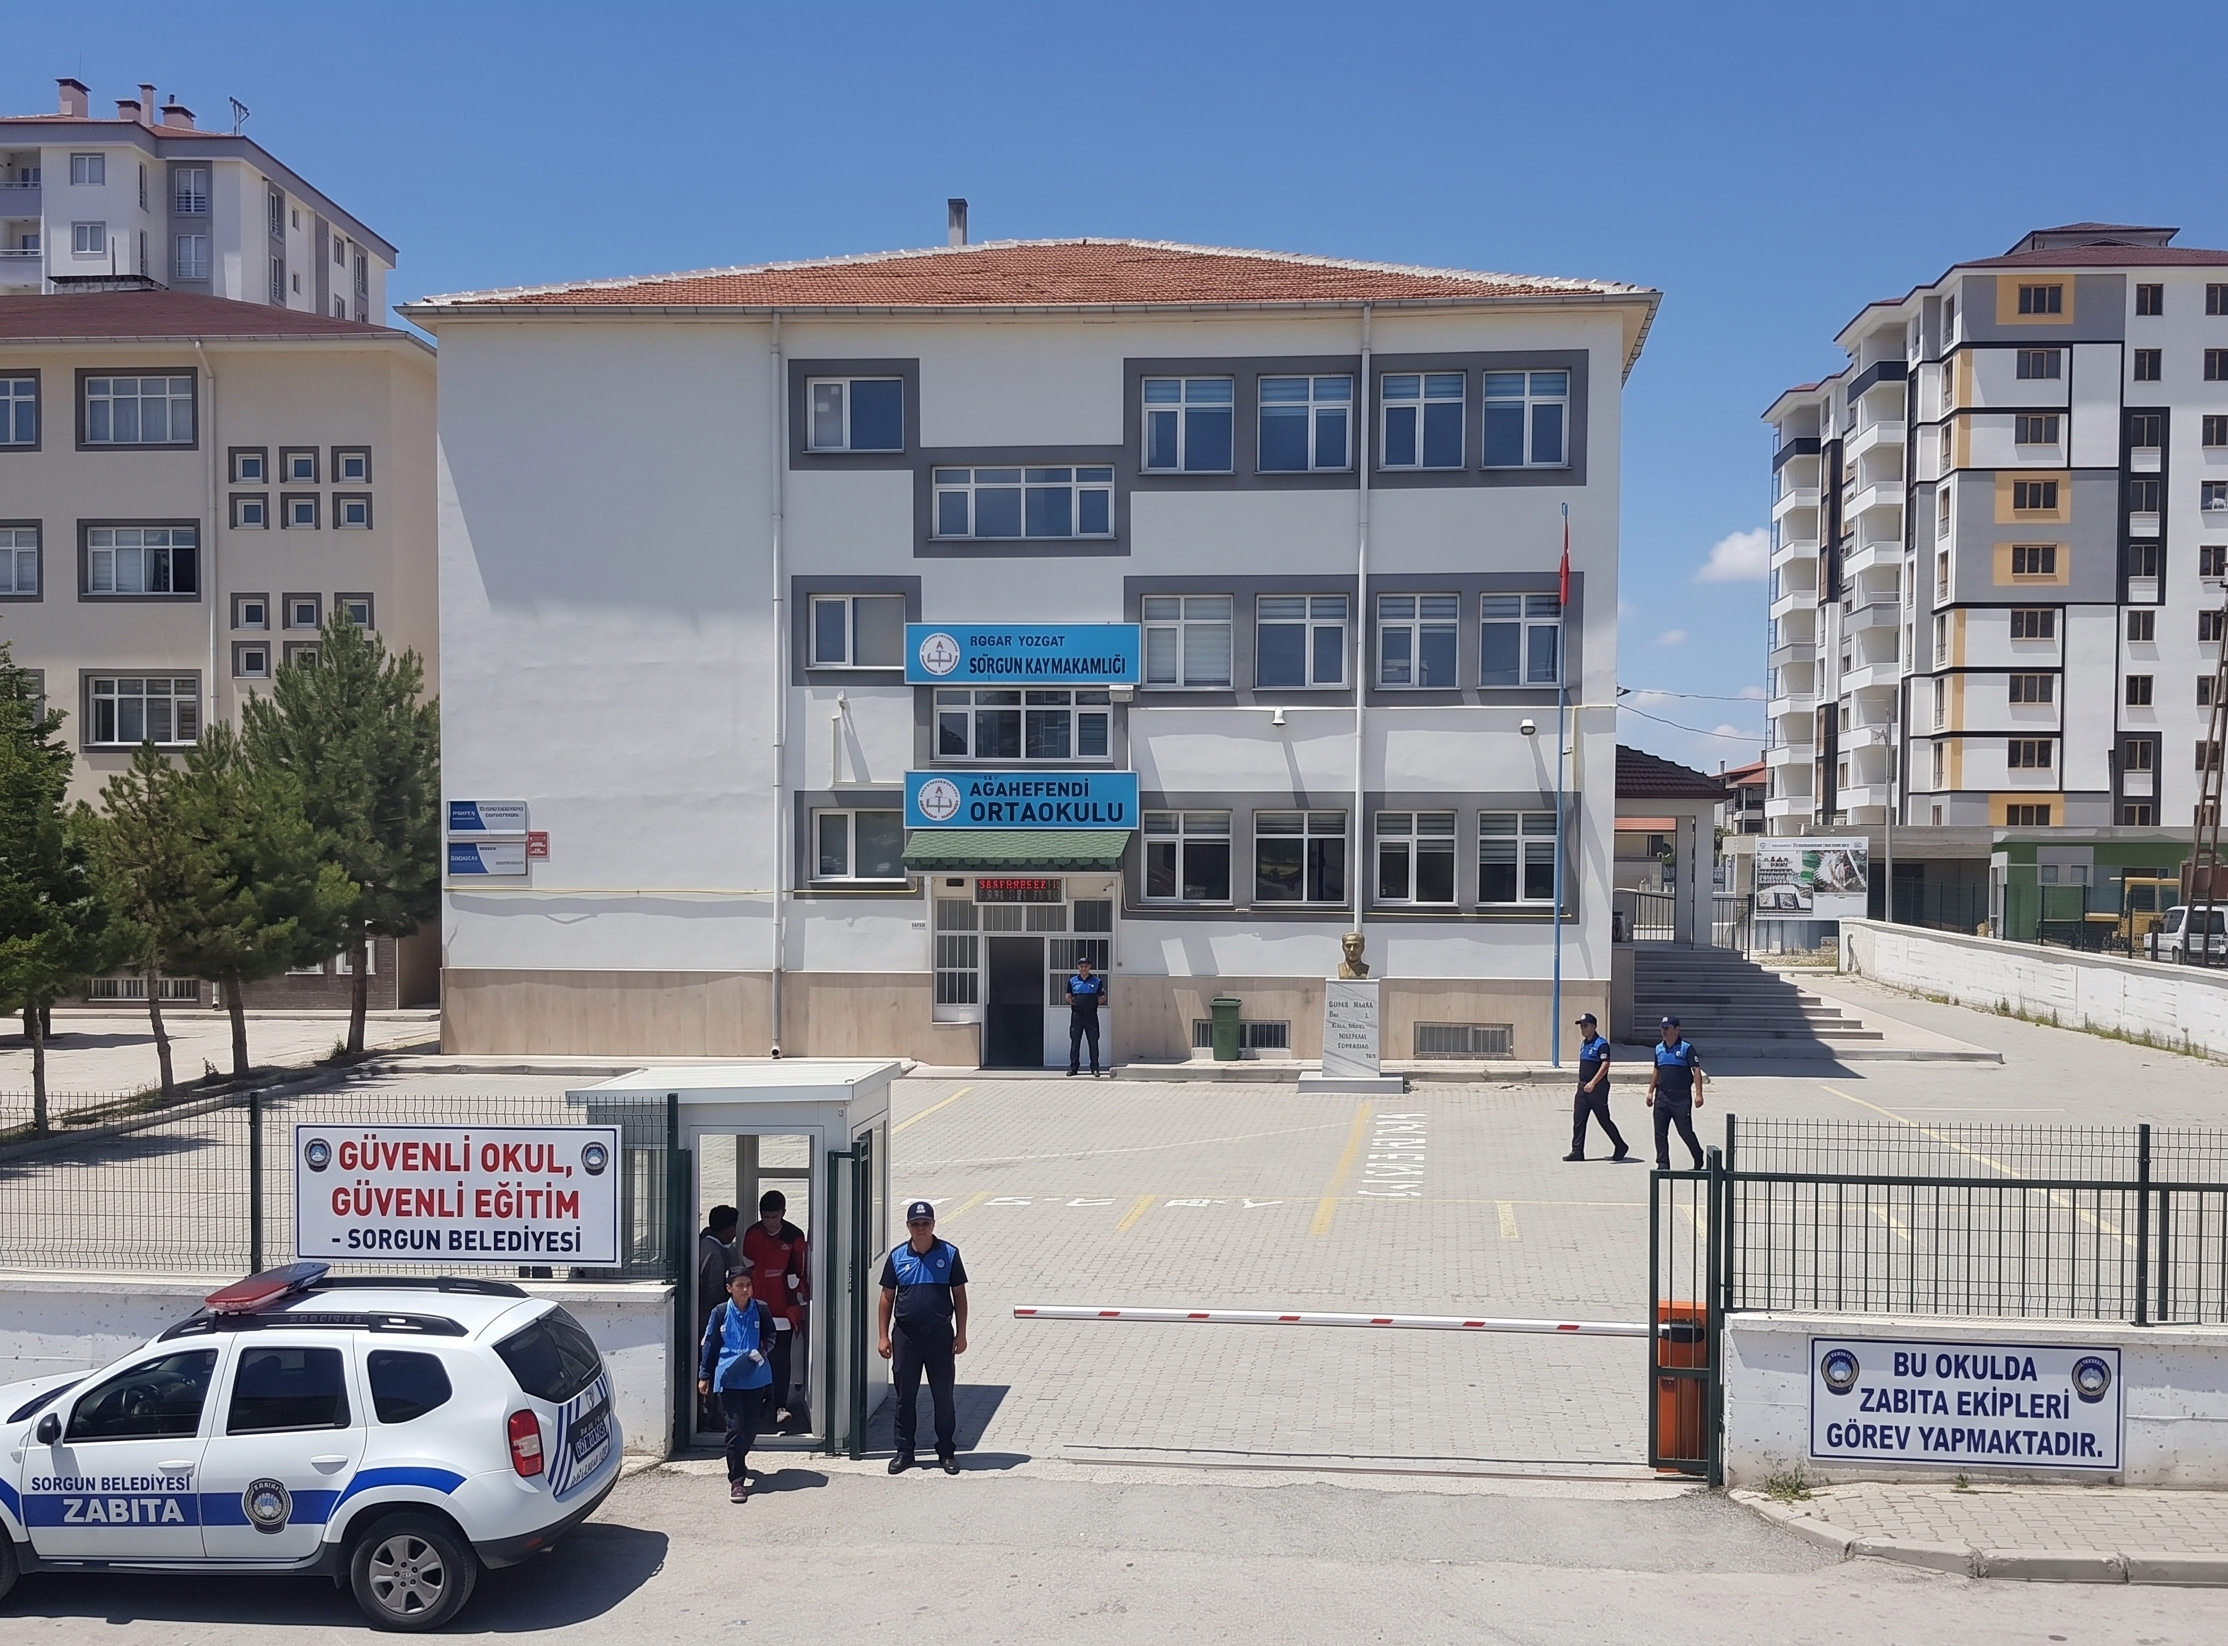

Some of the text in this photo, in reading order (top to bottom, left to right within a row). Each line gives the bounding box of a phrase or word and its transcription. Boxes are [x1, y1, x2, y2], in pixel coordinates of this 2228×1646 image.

[1018, 635, 1066, 647] YOZGAT
[970, 801, 1124, 823] ORTAOKULU
[339, 1134, 573, 1179] GÜVENLİ OKUL,
[332, 1179, 579, 1219] GÜVENLİ EĞİTİM
[347, 1228, 441, 1251] SORGUN
[448, 1225, 581, 1253] BELEDİYESİ
[1894, 1352, 2038, 1382] BU OKULDA
[1859, 1386, 2070, 1420] ZABITA EKİPLERİ
[1826, 1418, 2103, 1458] GÖREV YAPMAKTADIR.
[31, 1474, 190, 1492] SORGUN BELEDİYESİ
[63, 1498, 185, 1523] ZABITA
